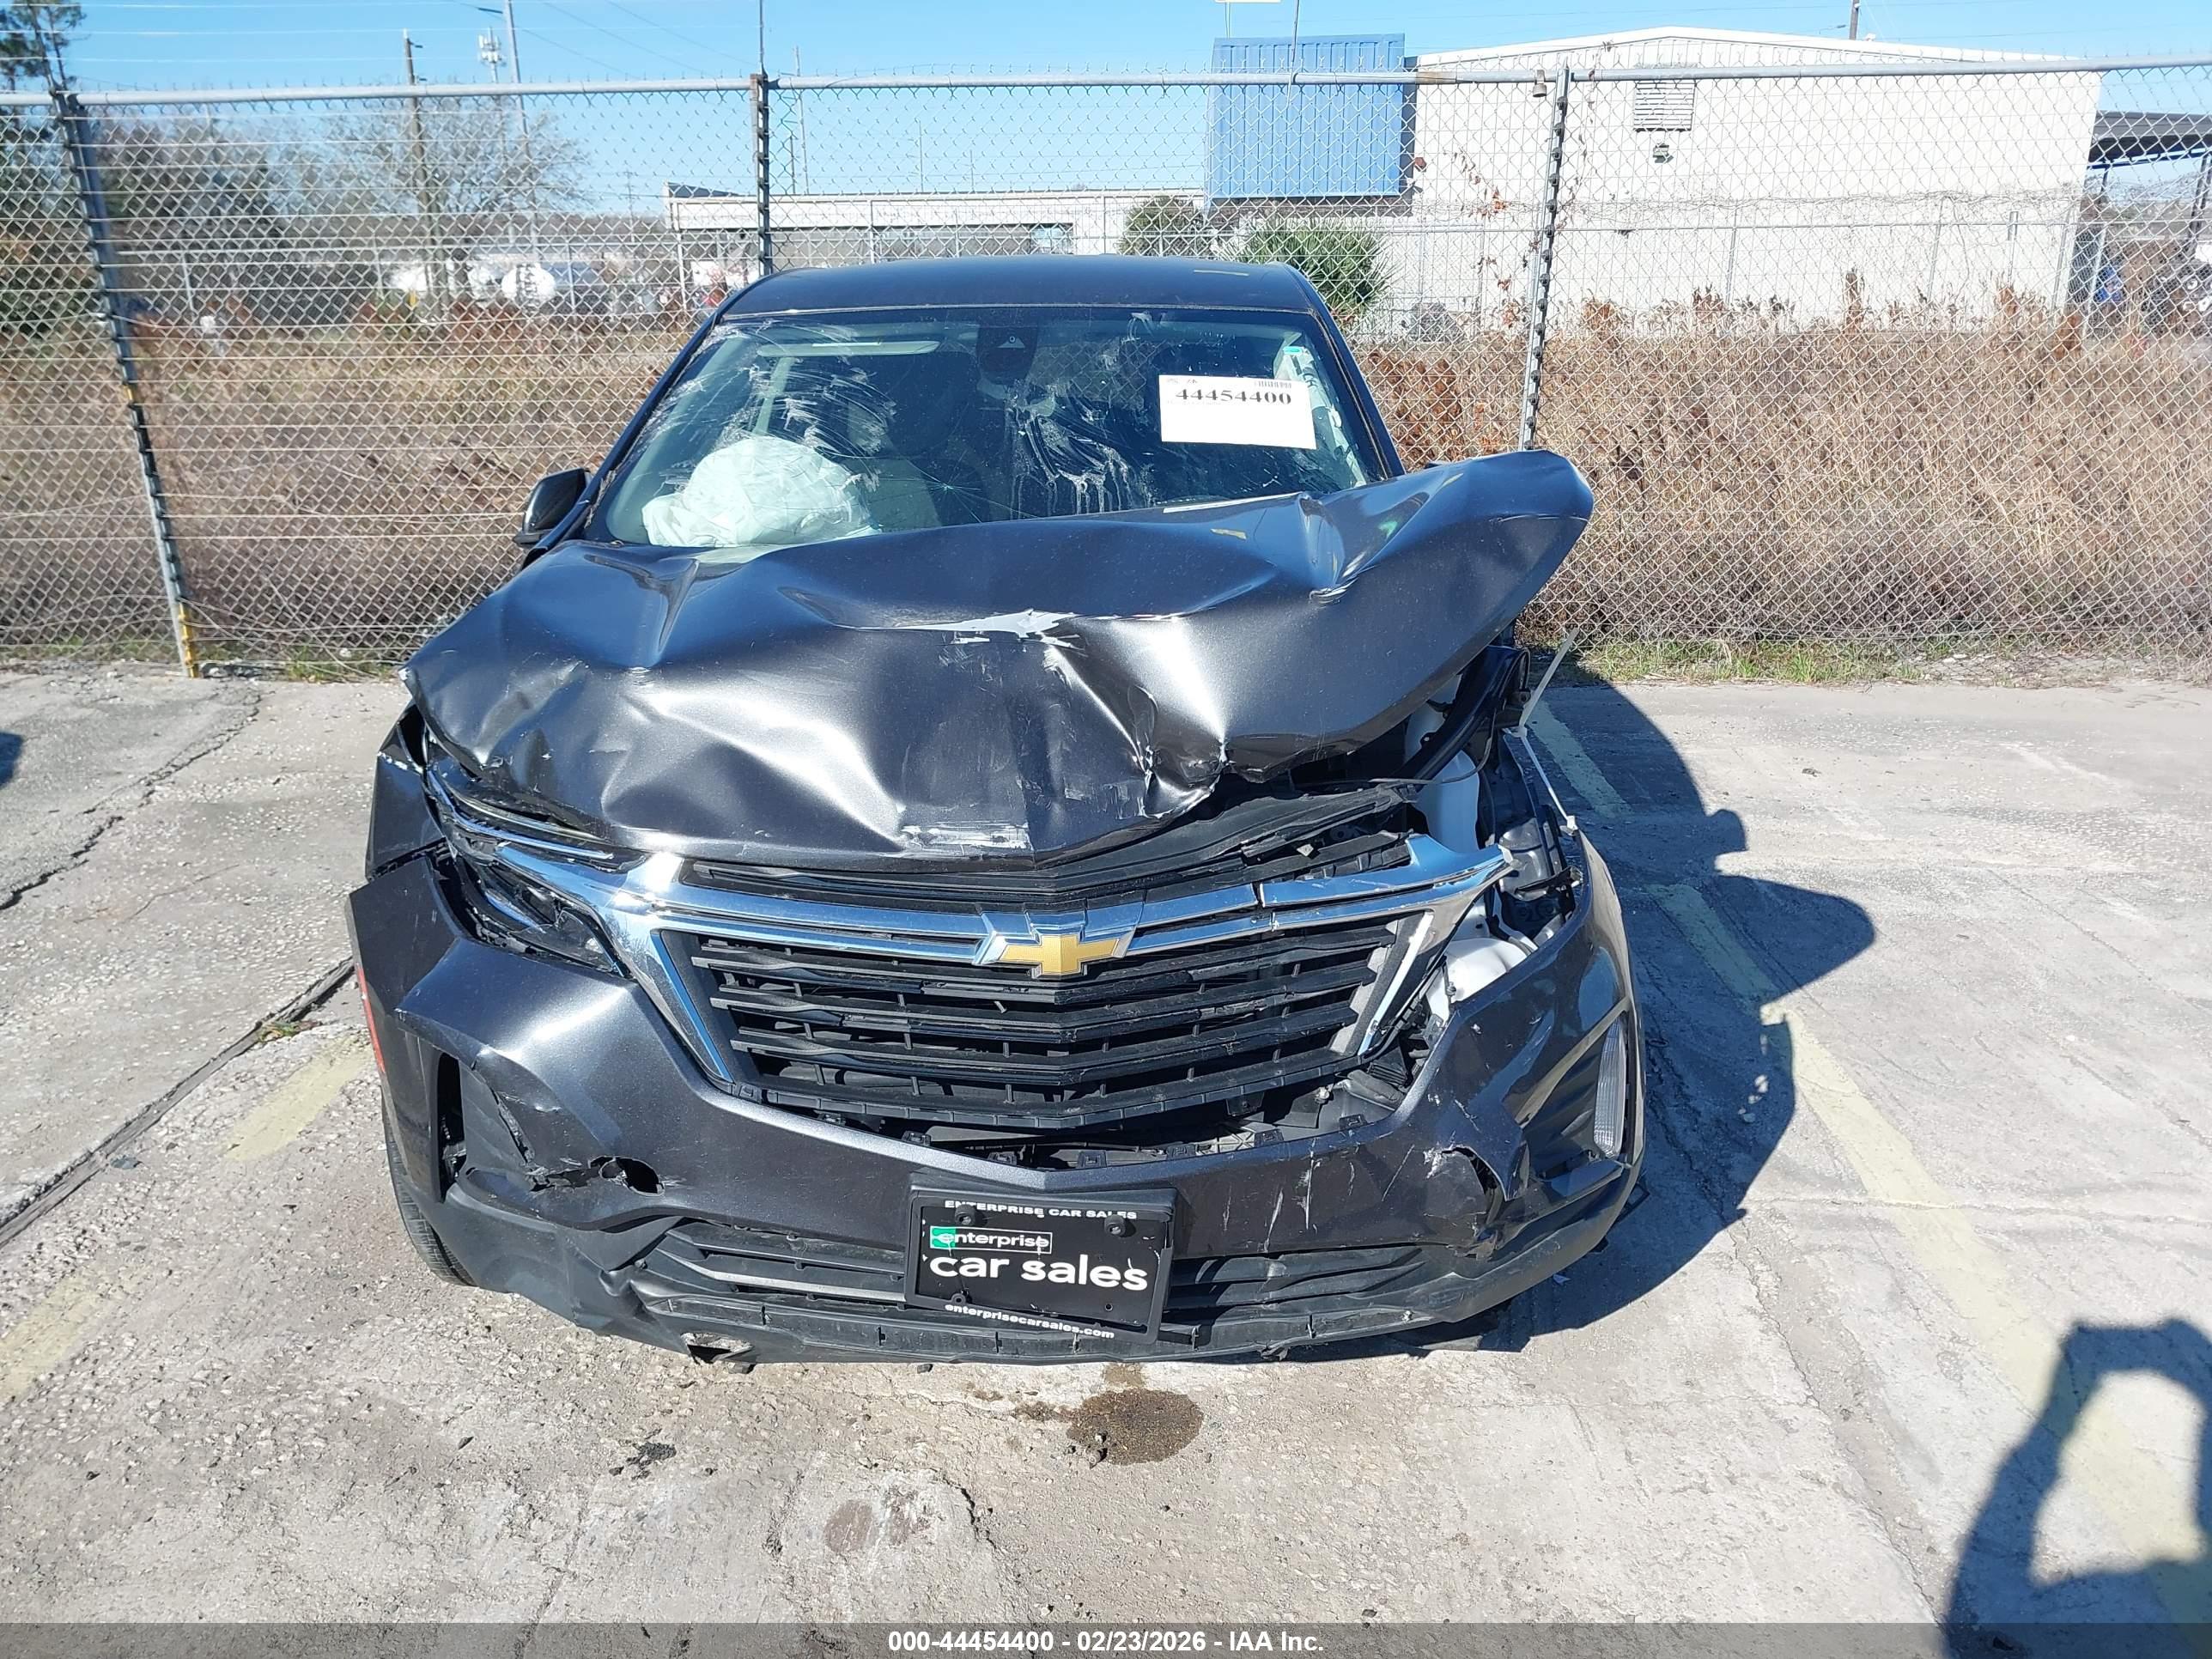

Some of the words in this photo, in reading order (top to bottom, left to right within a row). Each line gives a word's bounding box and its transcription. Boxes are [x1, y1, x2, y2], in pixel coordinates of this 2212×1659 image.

[1176, 388, 1291, 405] 44454400
[1048, 1208, 1082, 1218] CAR
[937, 1231, 1049, 1248] enterprise
[930, 1256, 1010, 1279] car
[1021, 1254, 1148, 1291] sales
[945, 1304, 1115, 1339] enterprisecarsales.com
